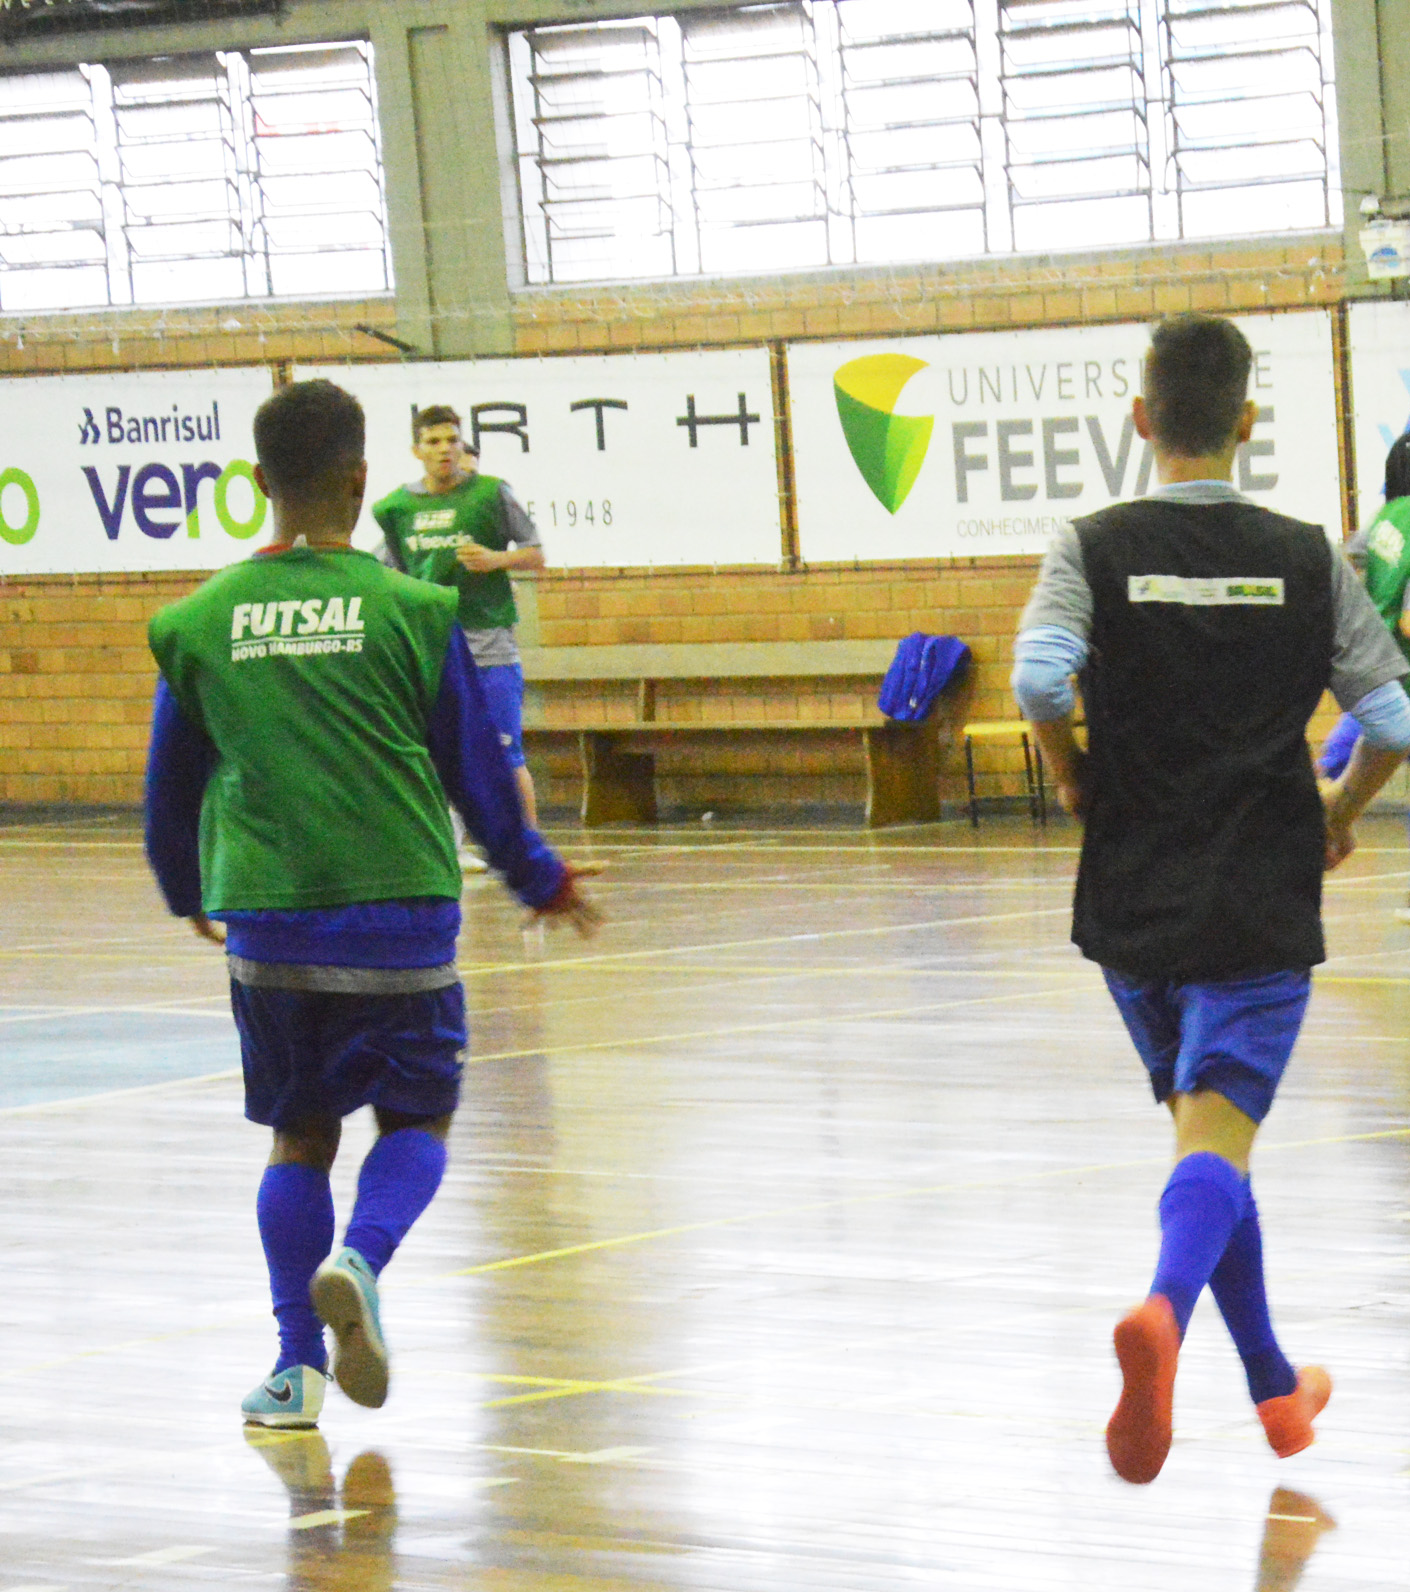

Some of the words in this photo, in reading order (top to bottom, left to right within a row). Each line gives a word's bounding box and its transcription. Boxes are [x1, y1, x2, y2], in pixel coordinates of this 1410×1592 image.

[947, 350, 1274, 406] UNIVERSIE
[106, 400, 221, 444] Banrisul
[951, 404, 1281, 504] FEEVE
[80, 459, 267, 541] vero
[549, 500, 613, 527] 1948
[231, 596, 365, 640] FUTSAL
[231, 644, 268, 662] NOVO
[269, 639, 364, 656] HAMBURGO-RS
